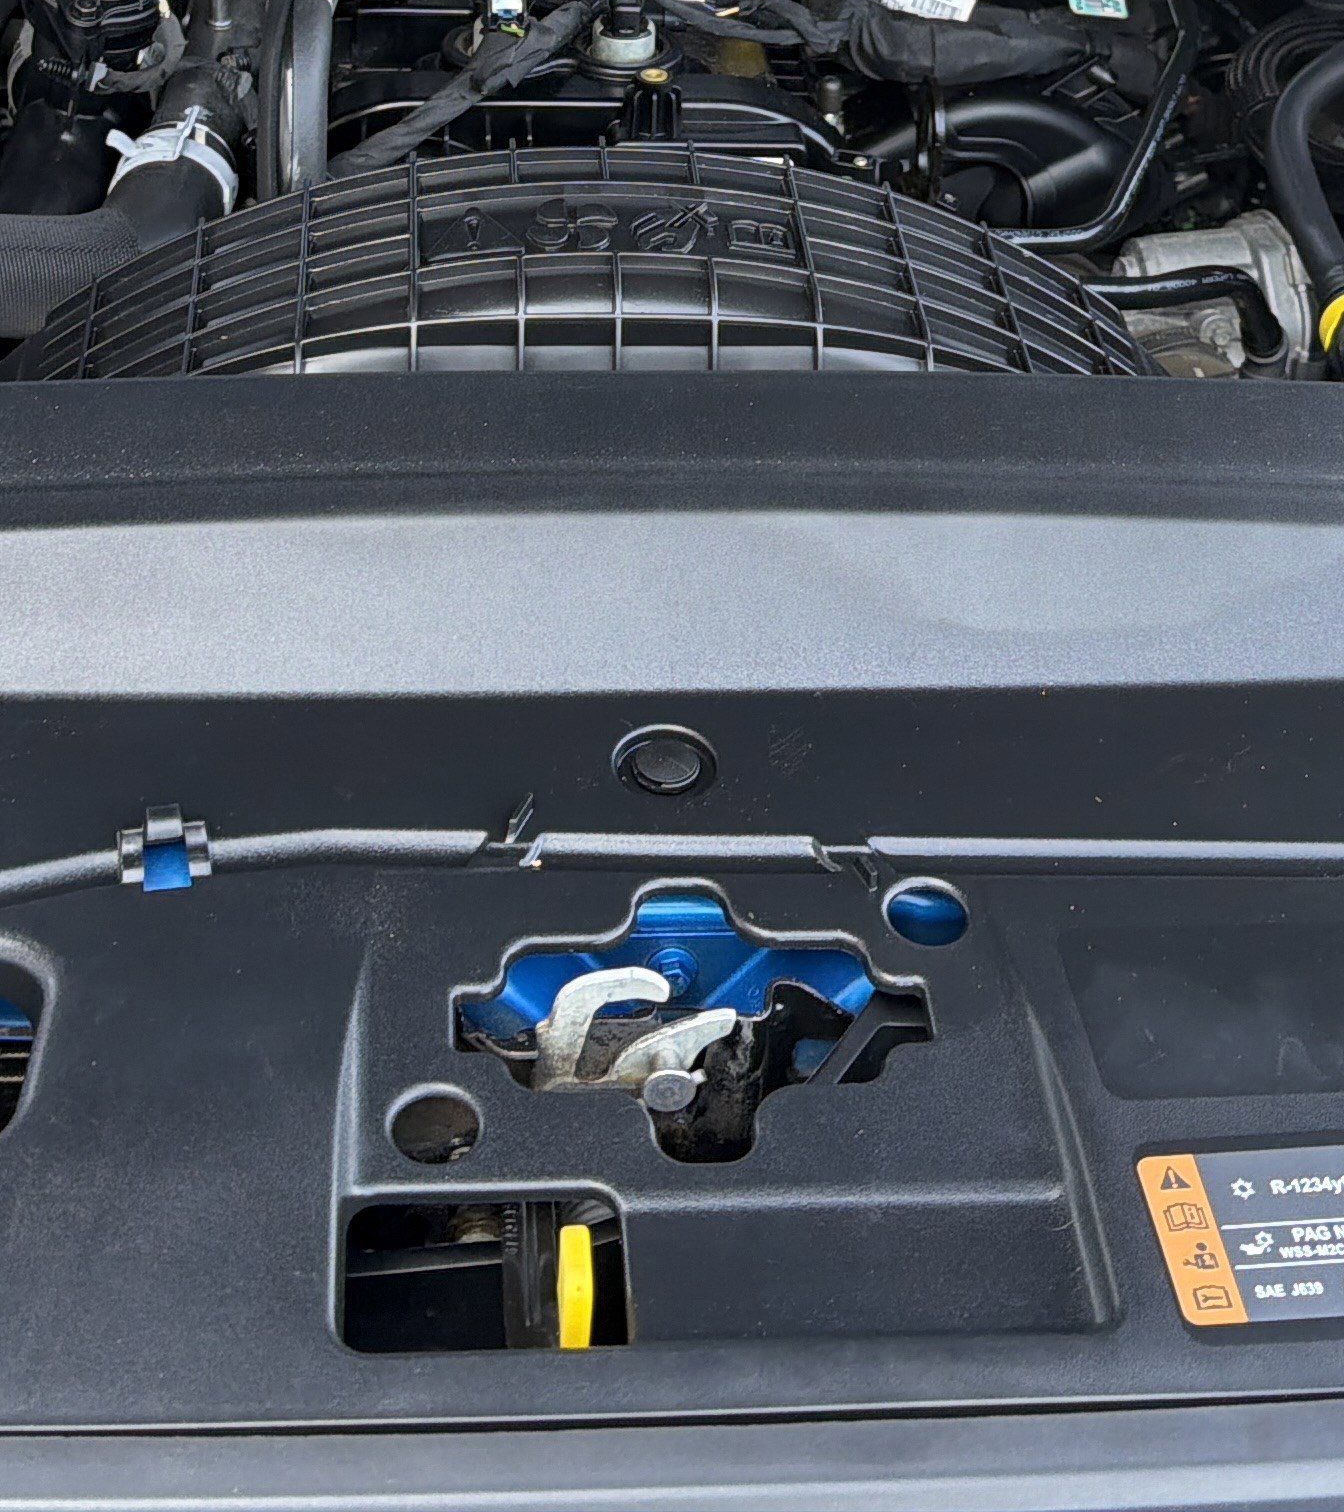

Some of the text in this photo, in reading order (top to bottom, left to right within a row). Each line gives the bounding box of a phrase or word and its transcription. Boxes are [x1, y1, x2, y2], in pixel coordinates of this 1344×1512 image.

[1291, 1225, 1332, 1243] PAG
[1254, 1282, 1325, 1299] SAE J639
